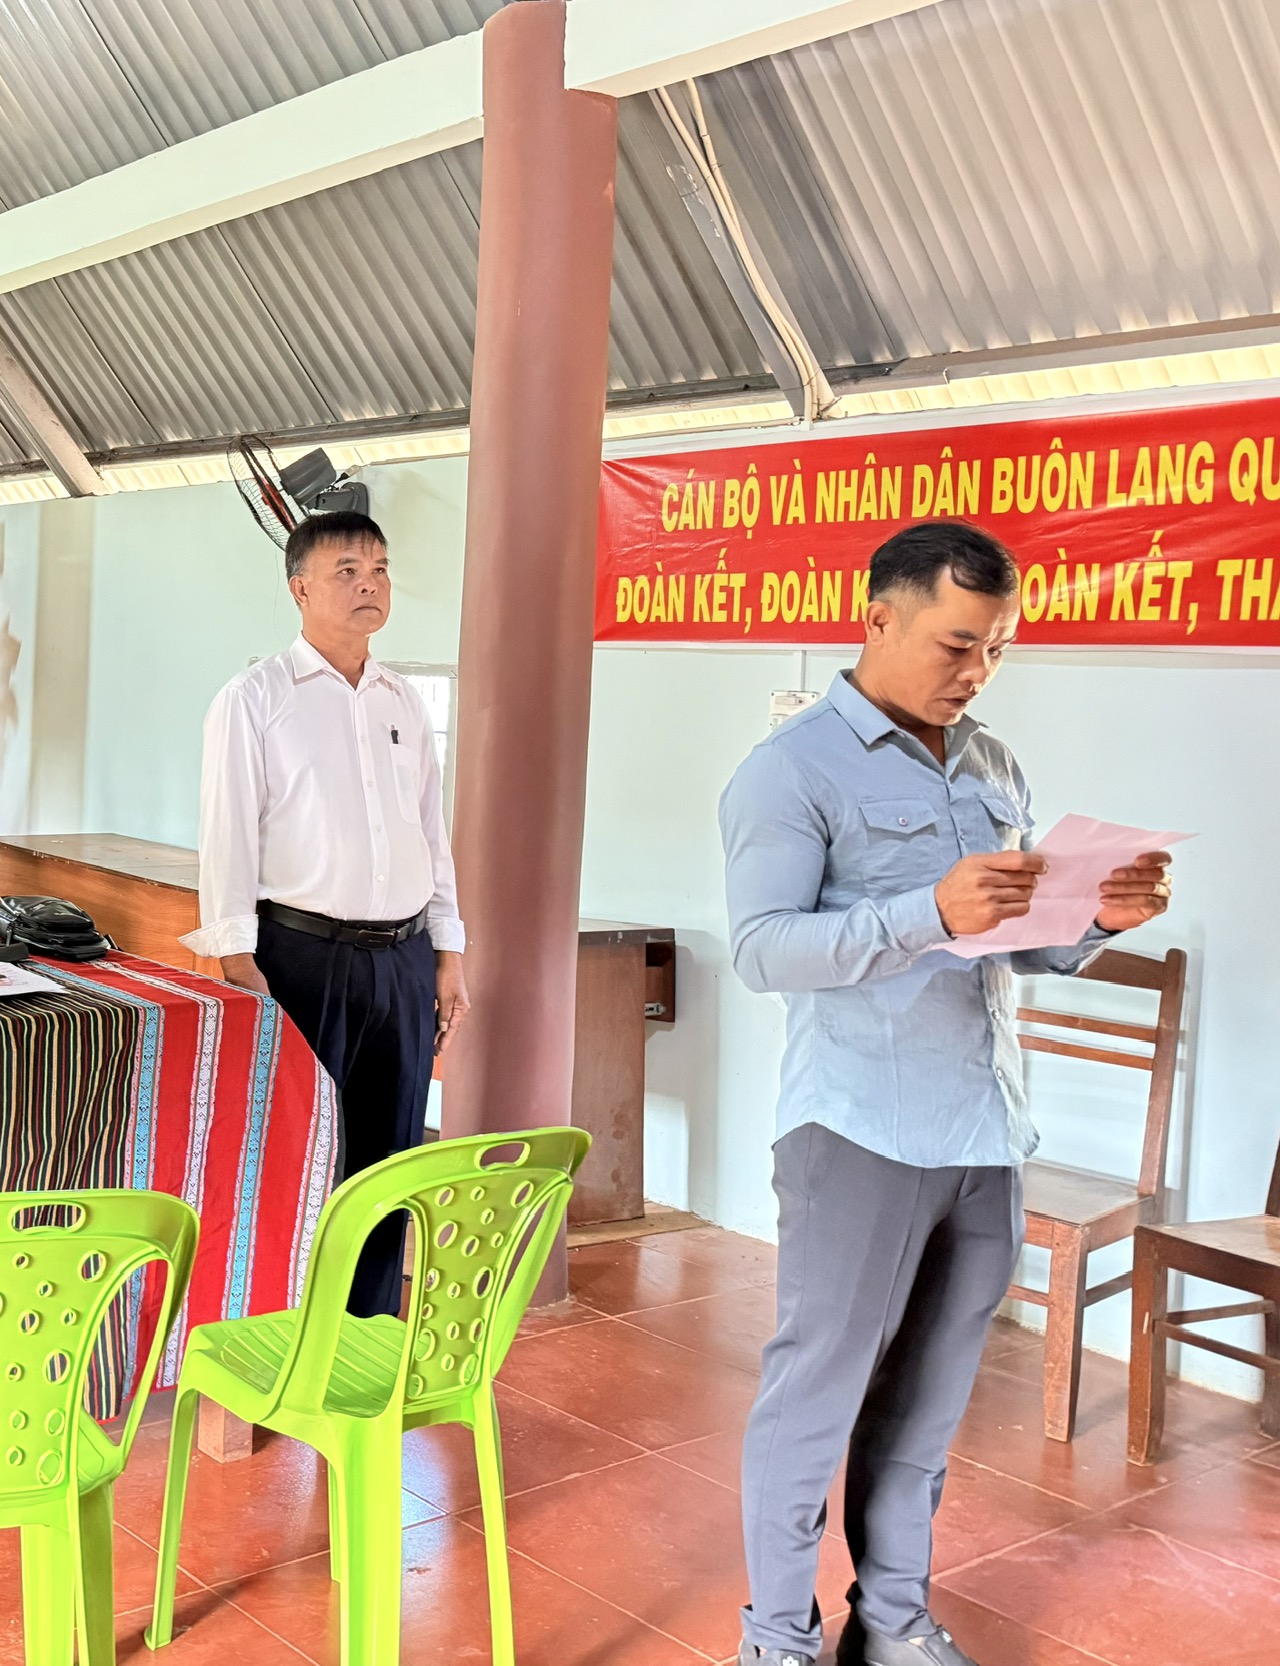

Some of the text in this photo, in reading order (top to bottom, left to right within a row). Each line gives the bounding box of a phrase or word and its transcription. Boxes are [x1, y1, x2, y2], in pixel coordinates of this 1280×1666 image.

[662, 468, 716, 532] CÁN
[722, 463, 761, 541] BỘ
[770, 457, 806, 526] VÀ
[815, 453, 903, 524] NHÂN
[912, 445, 982, 519] DÂN
[991, 436, 1096, 514] BUÔN
[1106, 441, 1215, 510] LANG
[615, 561, 686, 625] ĐOÀN
[693, 546, 753, 634] KẾT,
[760, 556, 843, 624] ĐOÀN
[1020, 547, 1101, 624] OÀN
[1109, 529, 1200, 636] KẾT,
